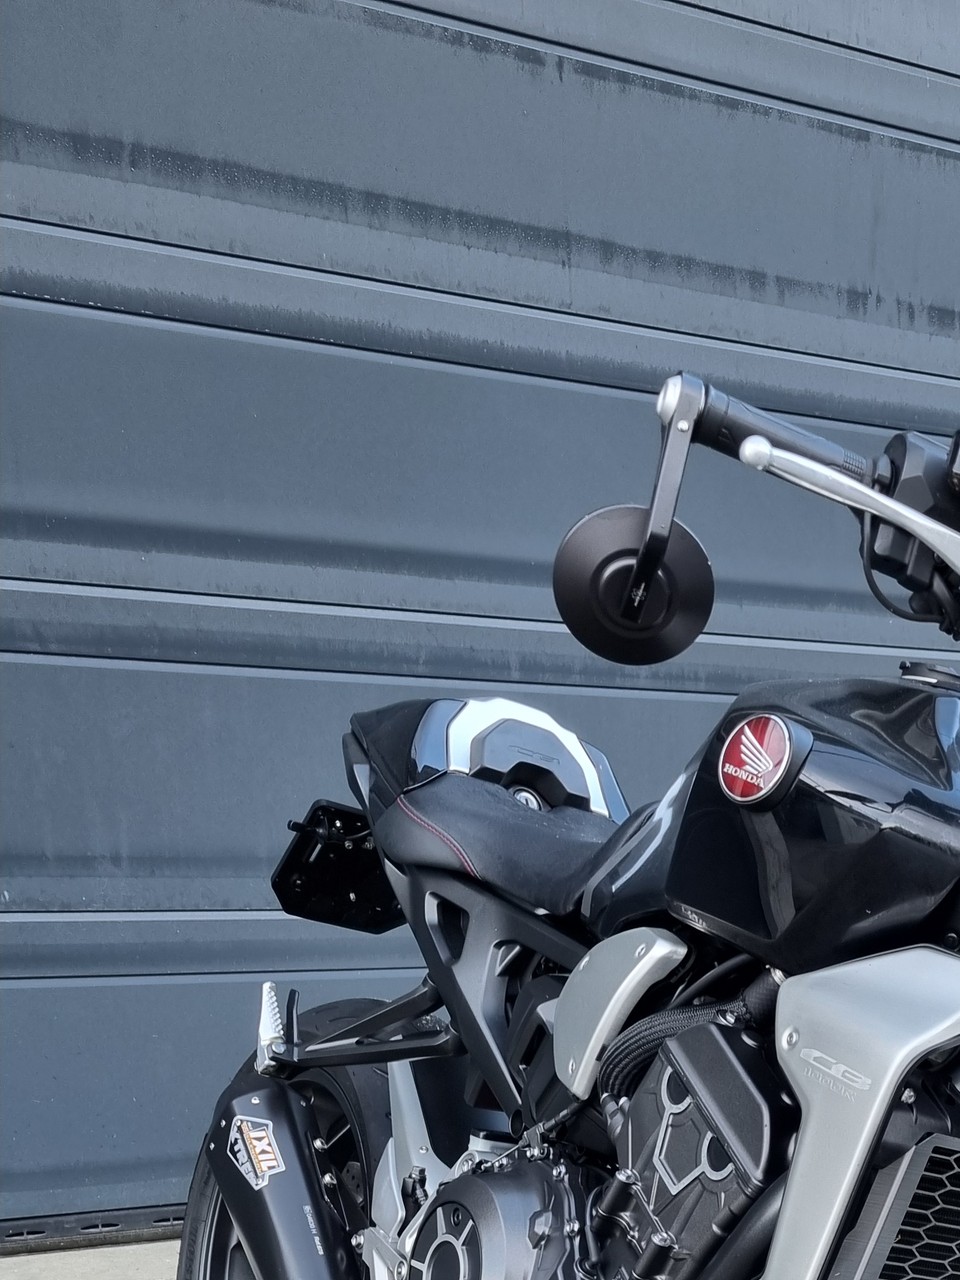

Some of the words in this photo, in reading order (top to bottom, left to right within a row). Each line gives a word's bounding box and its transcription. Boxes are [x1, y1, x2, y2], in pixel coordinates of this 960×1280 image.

[723, 763, 765, 789] HONDA
[799, 1048, 872, 1091] CB
[248, 1128, 280, 1172] IXIL
